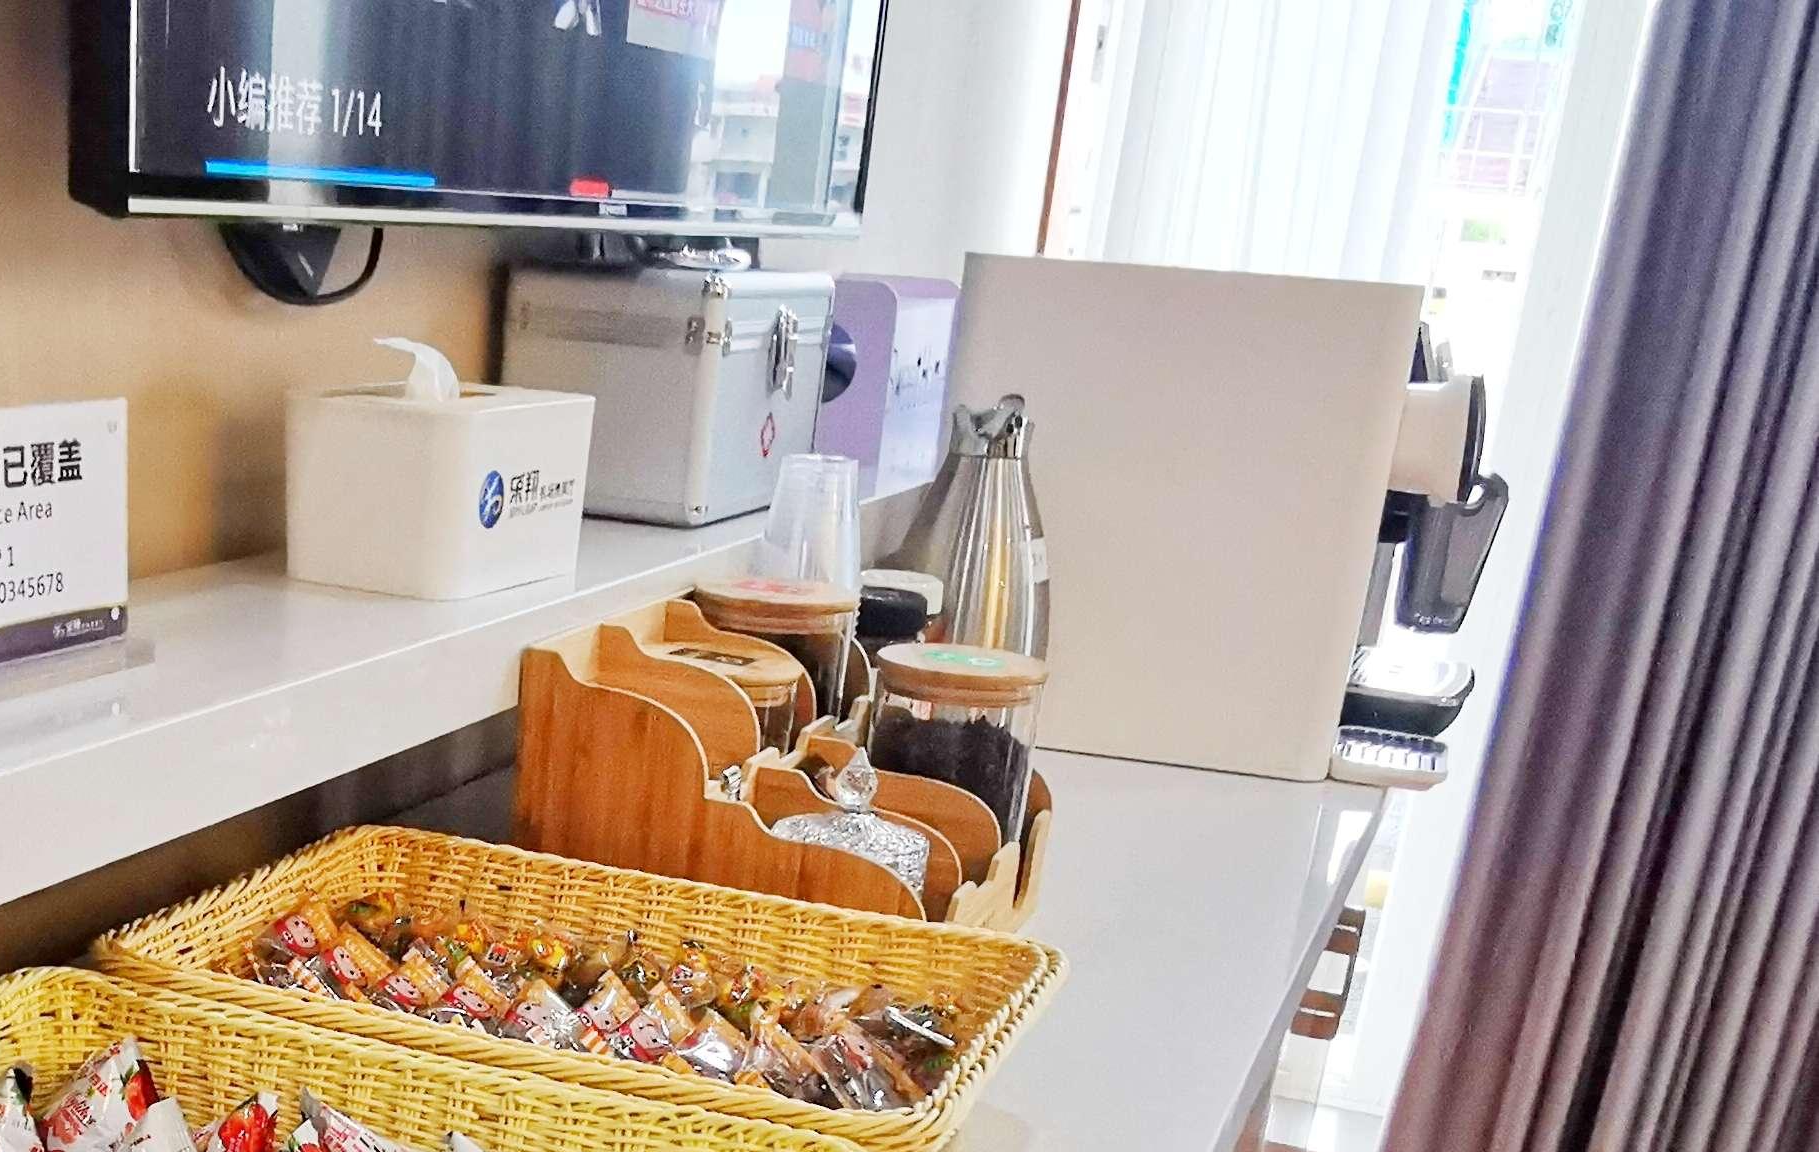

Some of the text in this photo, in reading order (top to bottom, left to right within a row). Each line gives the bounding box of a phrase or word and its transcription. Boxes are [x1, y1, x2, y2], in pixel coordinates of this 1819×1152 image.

[206, 64, 384, 139] 小编推荐 1/14
[17, 499, 53, 522] Area
